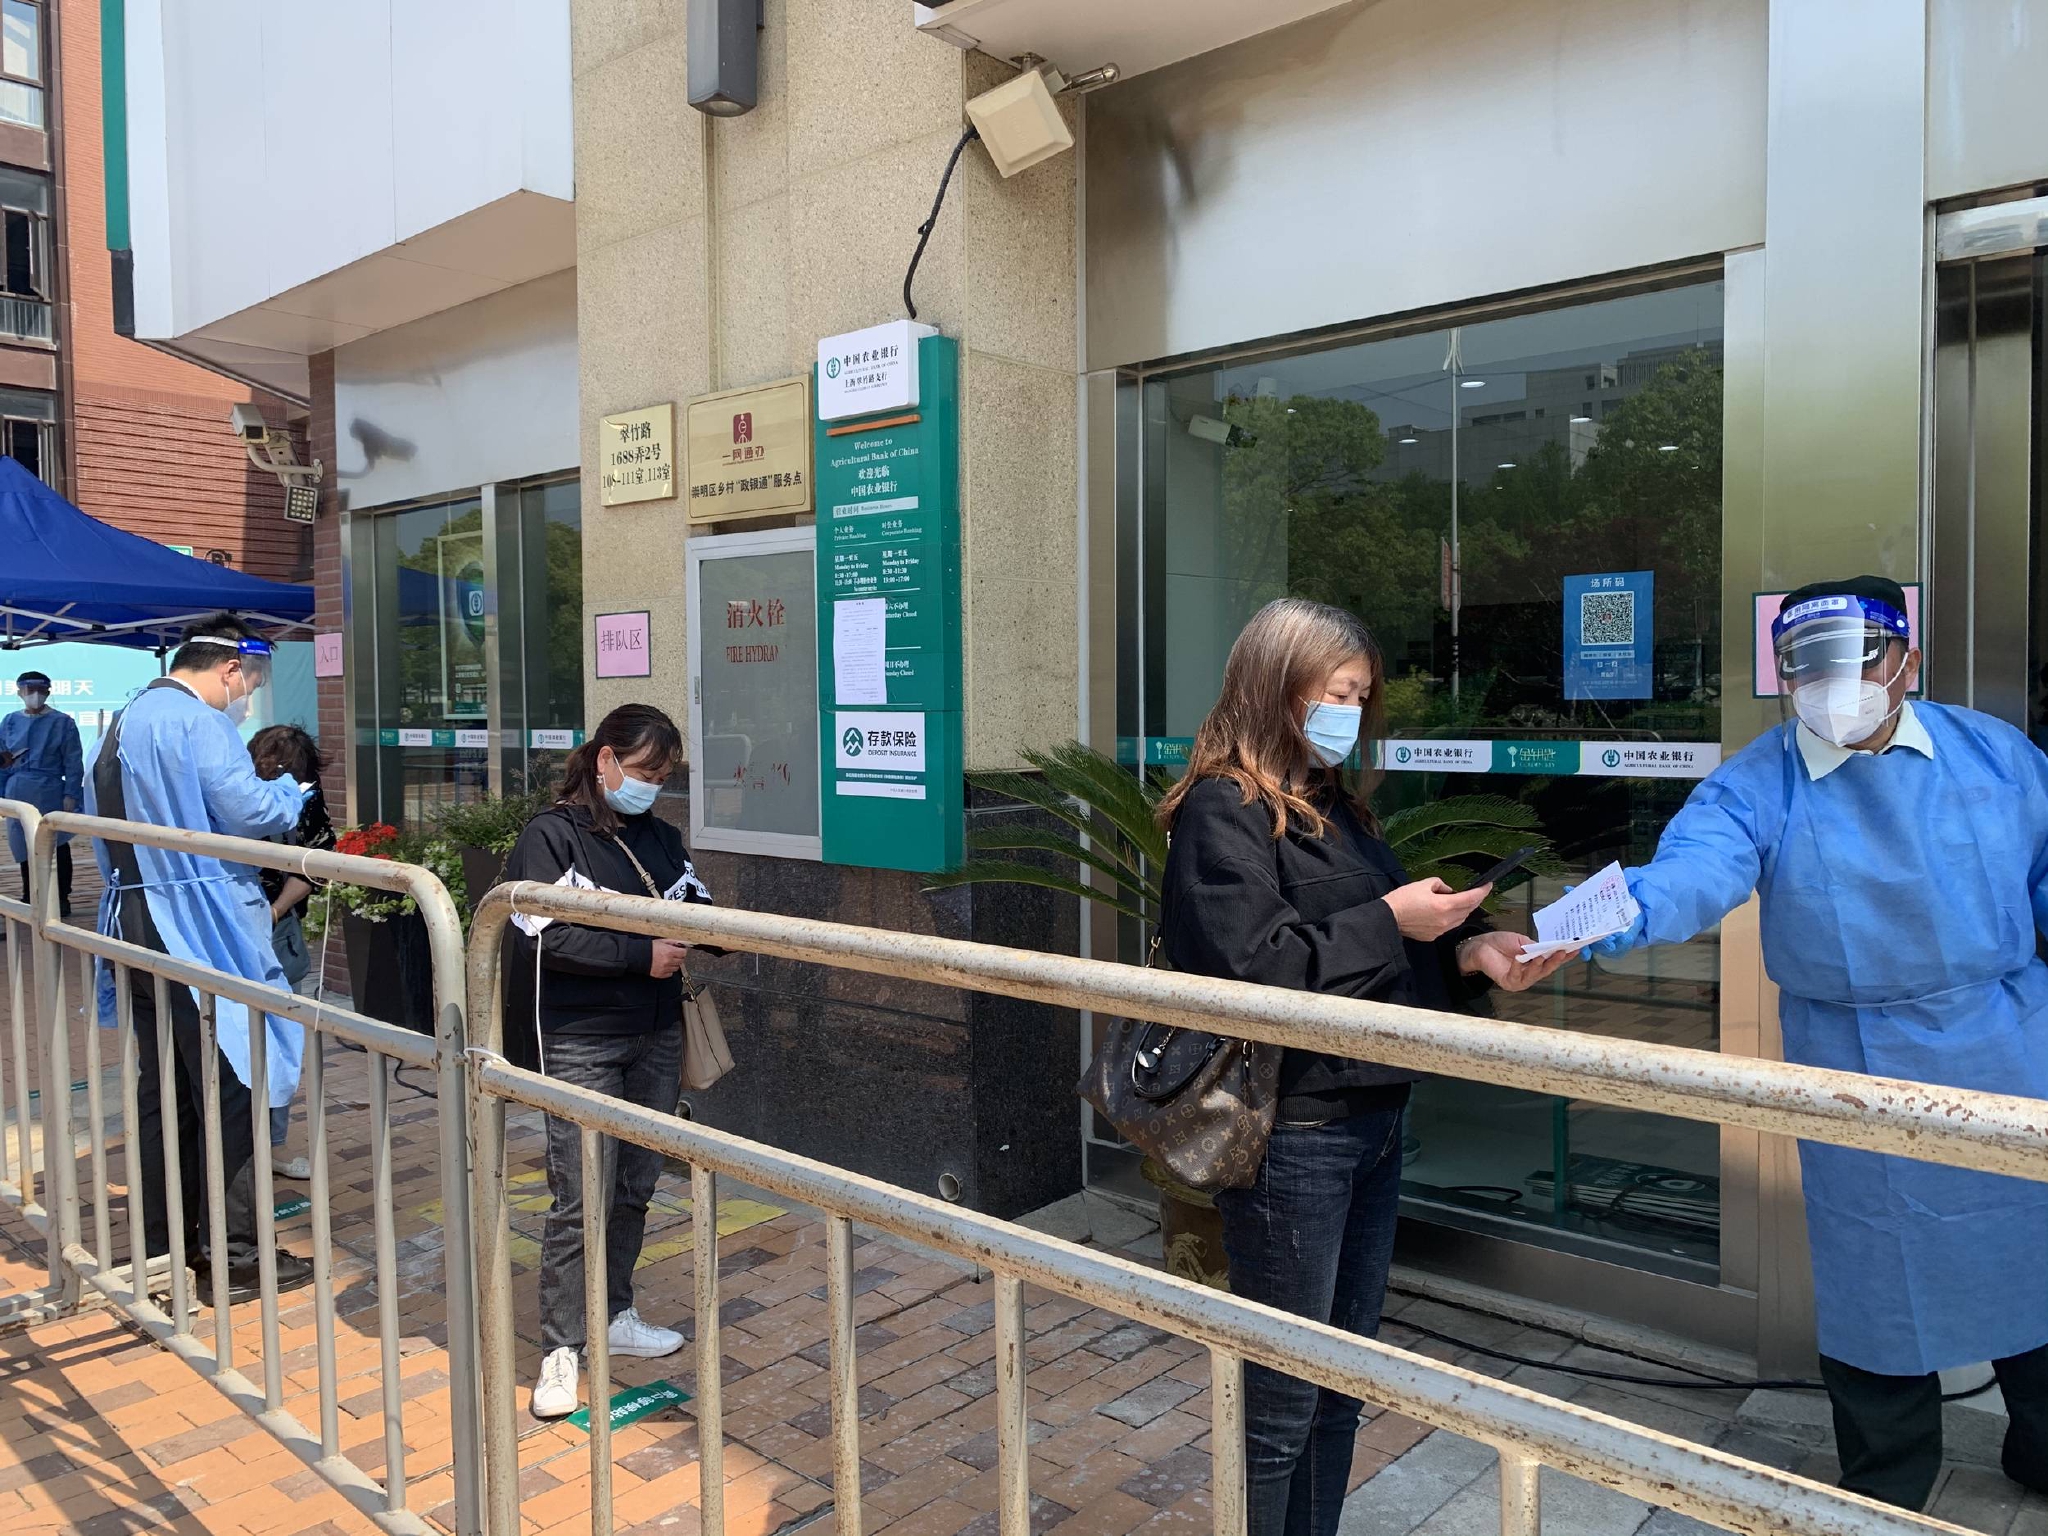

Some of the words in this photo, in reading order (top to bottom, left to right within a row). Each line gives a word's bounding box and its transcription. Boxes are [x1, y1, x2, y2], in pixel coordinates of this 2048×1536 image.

[844, 344, 898, 367] 中国农业银行
[620, 421, 651, 443] 翠竹路
[722, 445, 765, 461] 一网通办
[854, 440, 884, 451] Welcome
[885, 438, 893, 446] to
[611, 442, 661, 466] 1688弄2号
[830, 454, 870, 468] Agricultural
[872, 451, 889, 461] Bank
[890, 449, 897, 458] of
[898, 447, 919, 457] China
[858, 465, 890, 480] 欢迎光临
[851, 481, 898, 497] 中国农业银行
[1590, 577, 1625, 588] 场所码
[727, 598, 785, 629] 消火栓
[601, 628, 642, 651] 排队区
[320, 646, 338, 664] 入口
[726, 646, 743, 663] FIRE
[868, 731, 917, 748] 存款保险
[889, 750, 917, 758] INSURANCE
[1414, 747, 1473, 758] 中国农业银行
[1624, 750, 1694, 762] 中国农业银行
